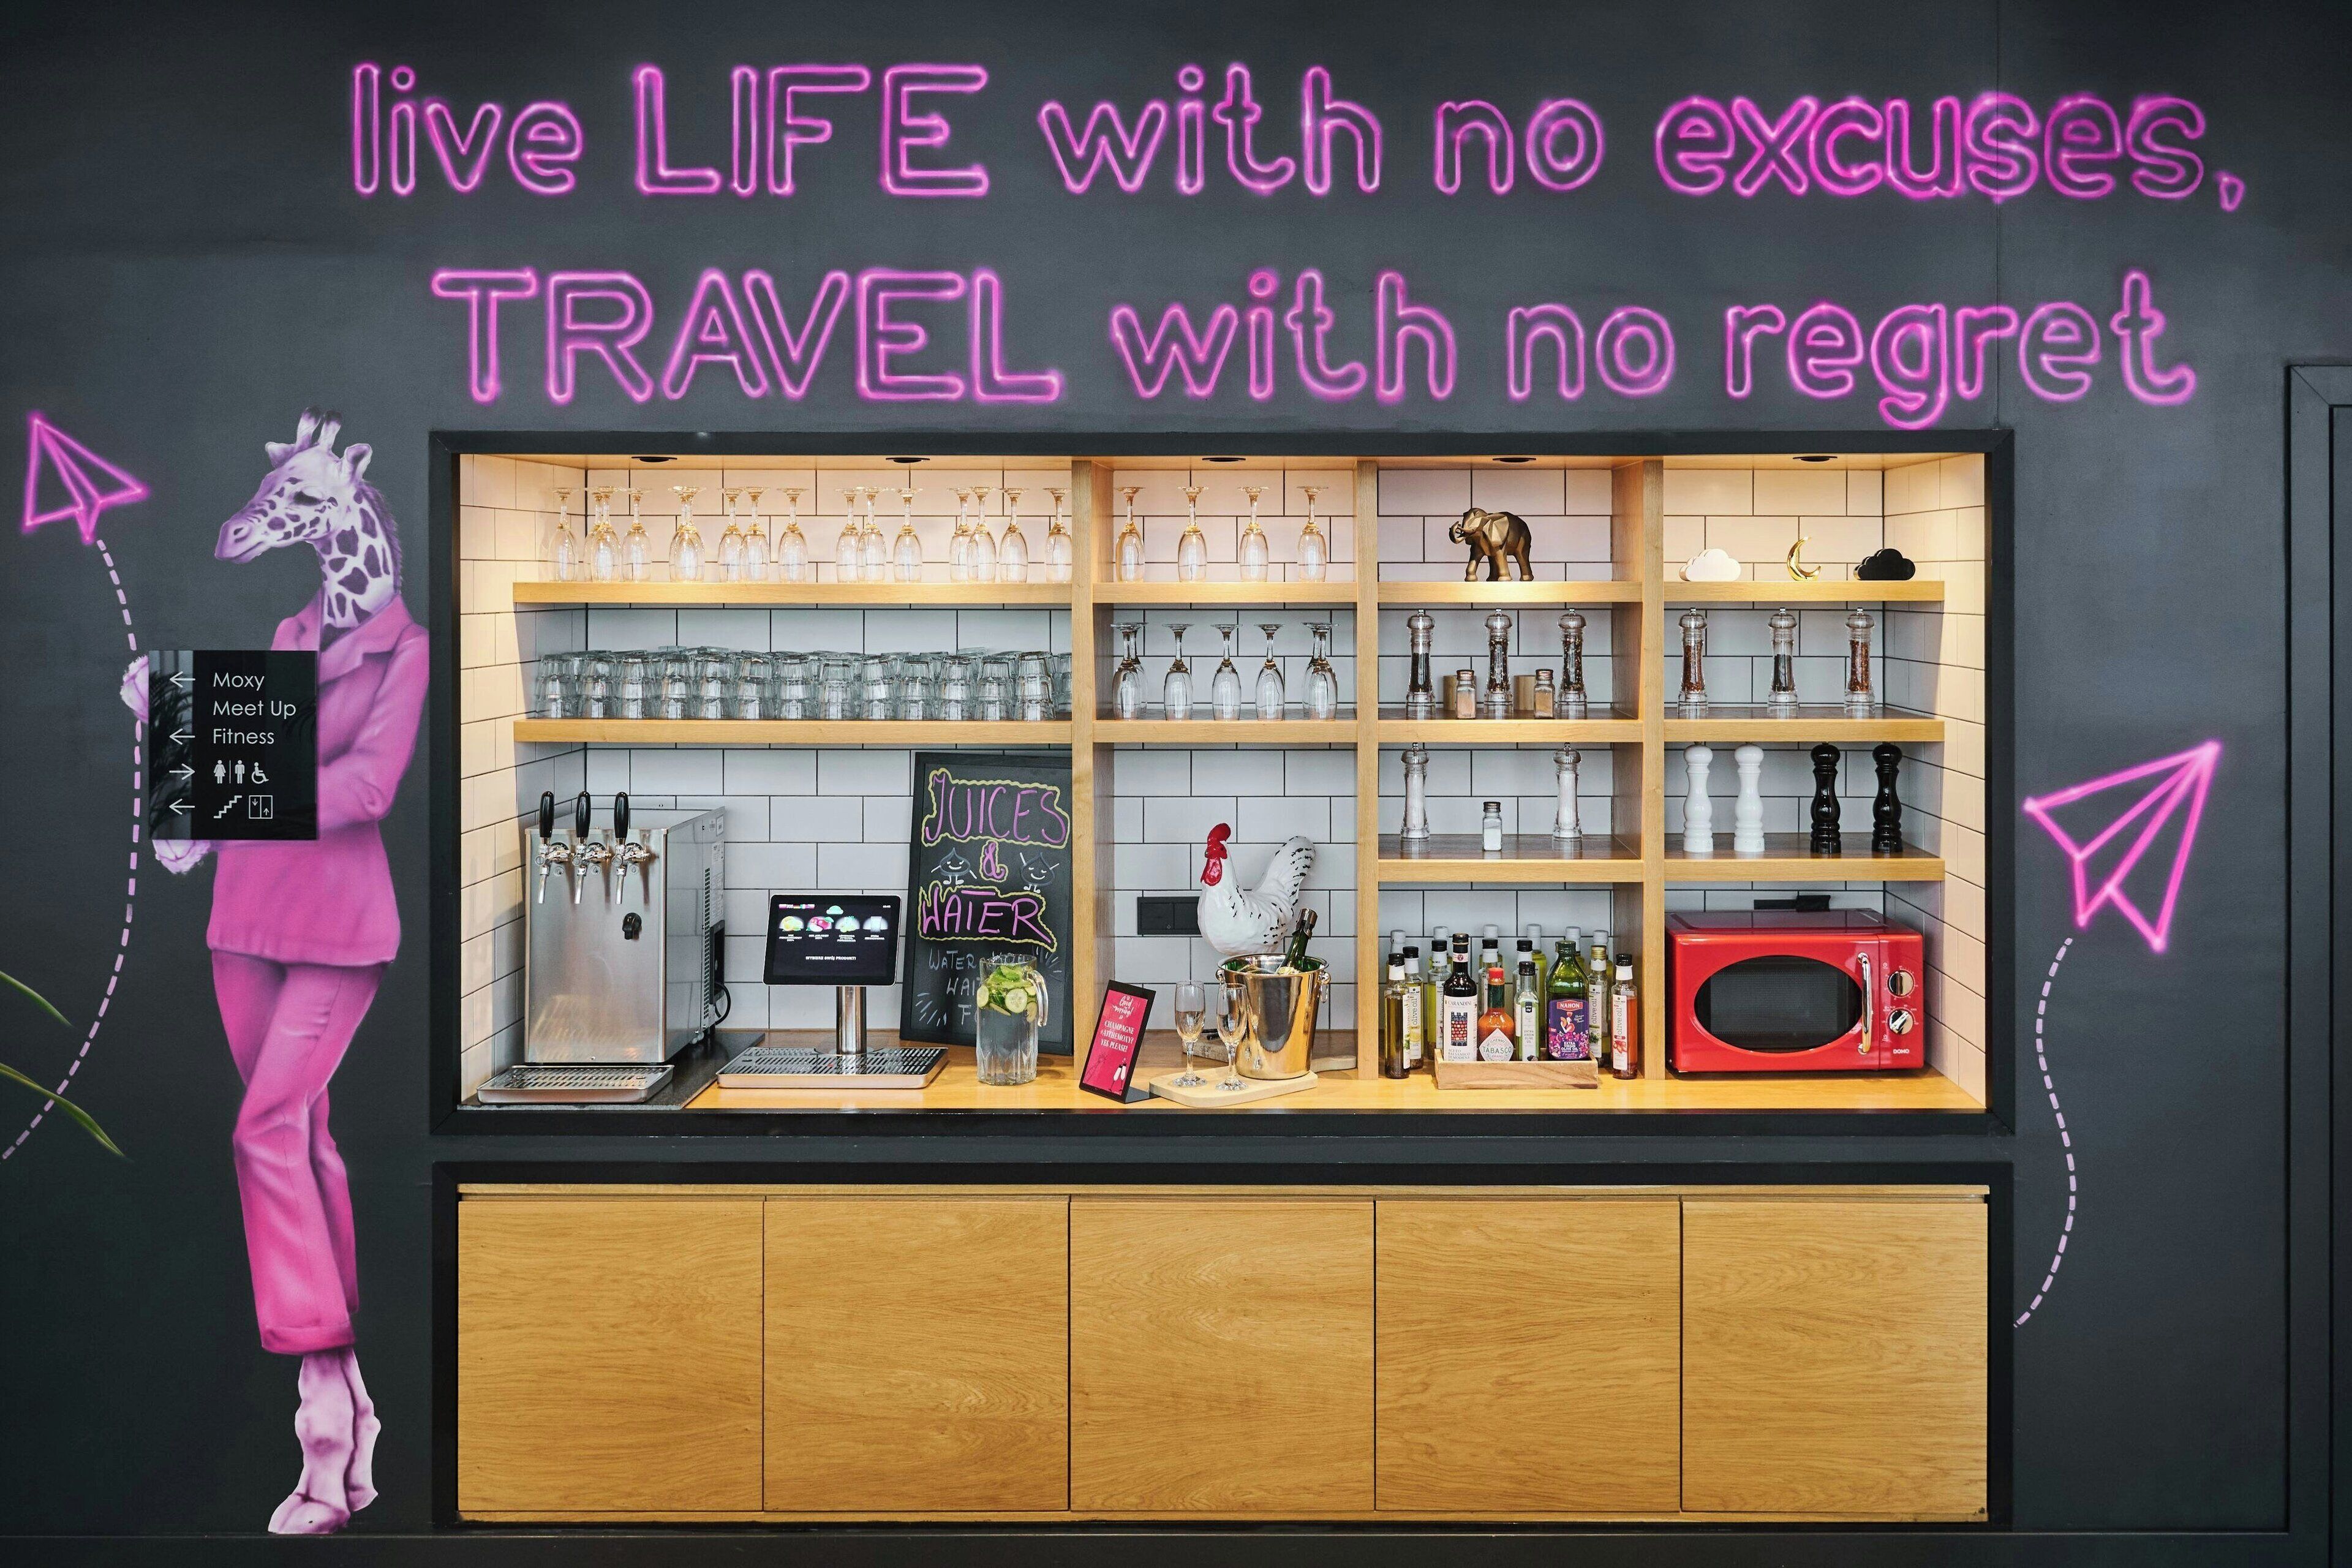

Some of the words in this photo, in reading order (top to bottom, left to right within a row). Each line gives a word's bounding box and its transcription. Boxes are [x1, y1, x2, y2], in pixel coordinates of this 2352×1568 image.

[351, 60, 586, 198] live
[631, 61, 991, 200] LIFE
[1036, 62, 1383, 198] with
[1433, 97, 1607, 197] no
[1653, 90, 2246, 213] excuses,
[428, 265, 1066, 407] TRAVEL
[1108, 267, 1457, 406] with
[1506, 303, 1676, 403] no
[1723, 268, 2198, 432] regret
[213, 672, 265, 692] Moxy
[213, 700, 264, 716] Meet
[271, 700, 296, 720] Up
[213, 728, 275, 745] Fitness
[925, 773, 1066, 845] JUICES
[983, 841, 1006, 880] &
[922, 886, 1052, 944] WATER
[1104, 1020, 1135, 1035] CHAMPAGNE
[1100, 1038, 1109, 1047] YES
[1109, 1041, 1128, 1053] PLEASE!
